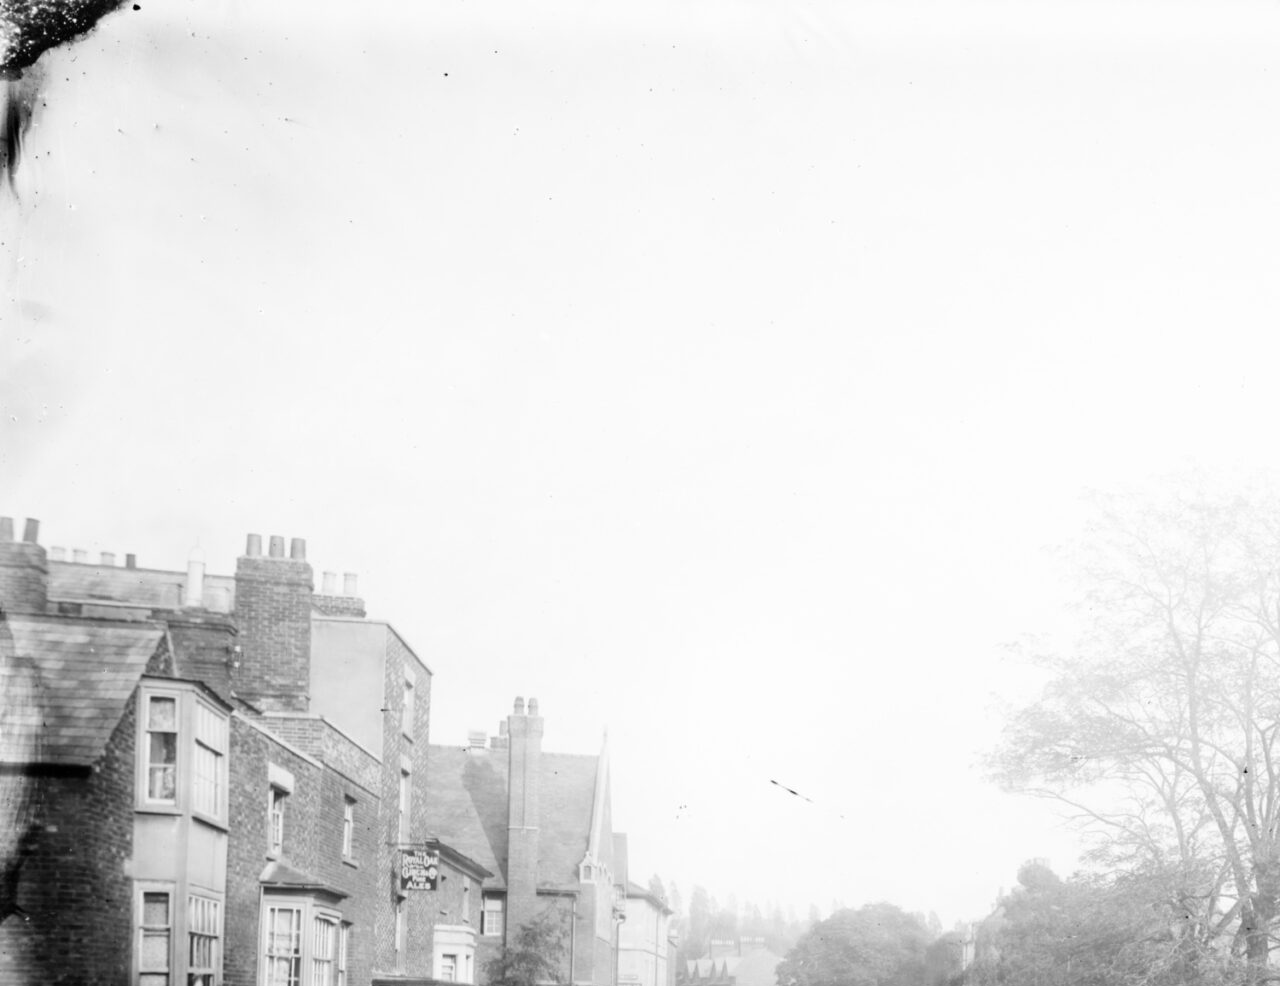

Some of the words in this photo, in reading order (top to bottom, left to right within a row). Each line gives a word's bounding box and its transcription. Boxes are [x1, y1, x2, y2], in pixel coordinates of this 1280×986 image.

[402, 853, 424, 867] ROYAL
[424, 855, 439, 867] OAK
[406, 880, 431, 890] ALES
